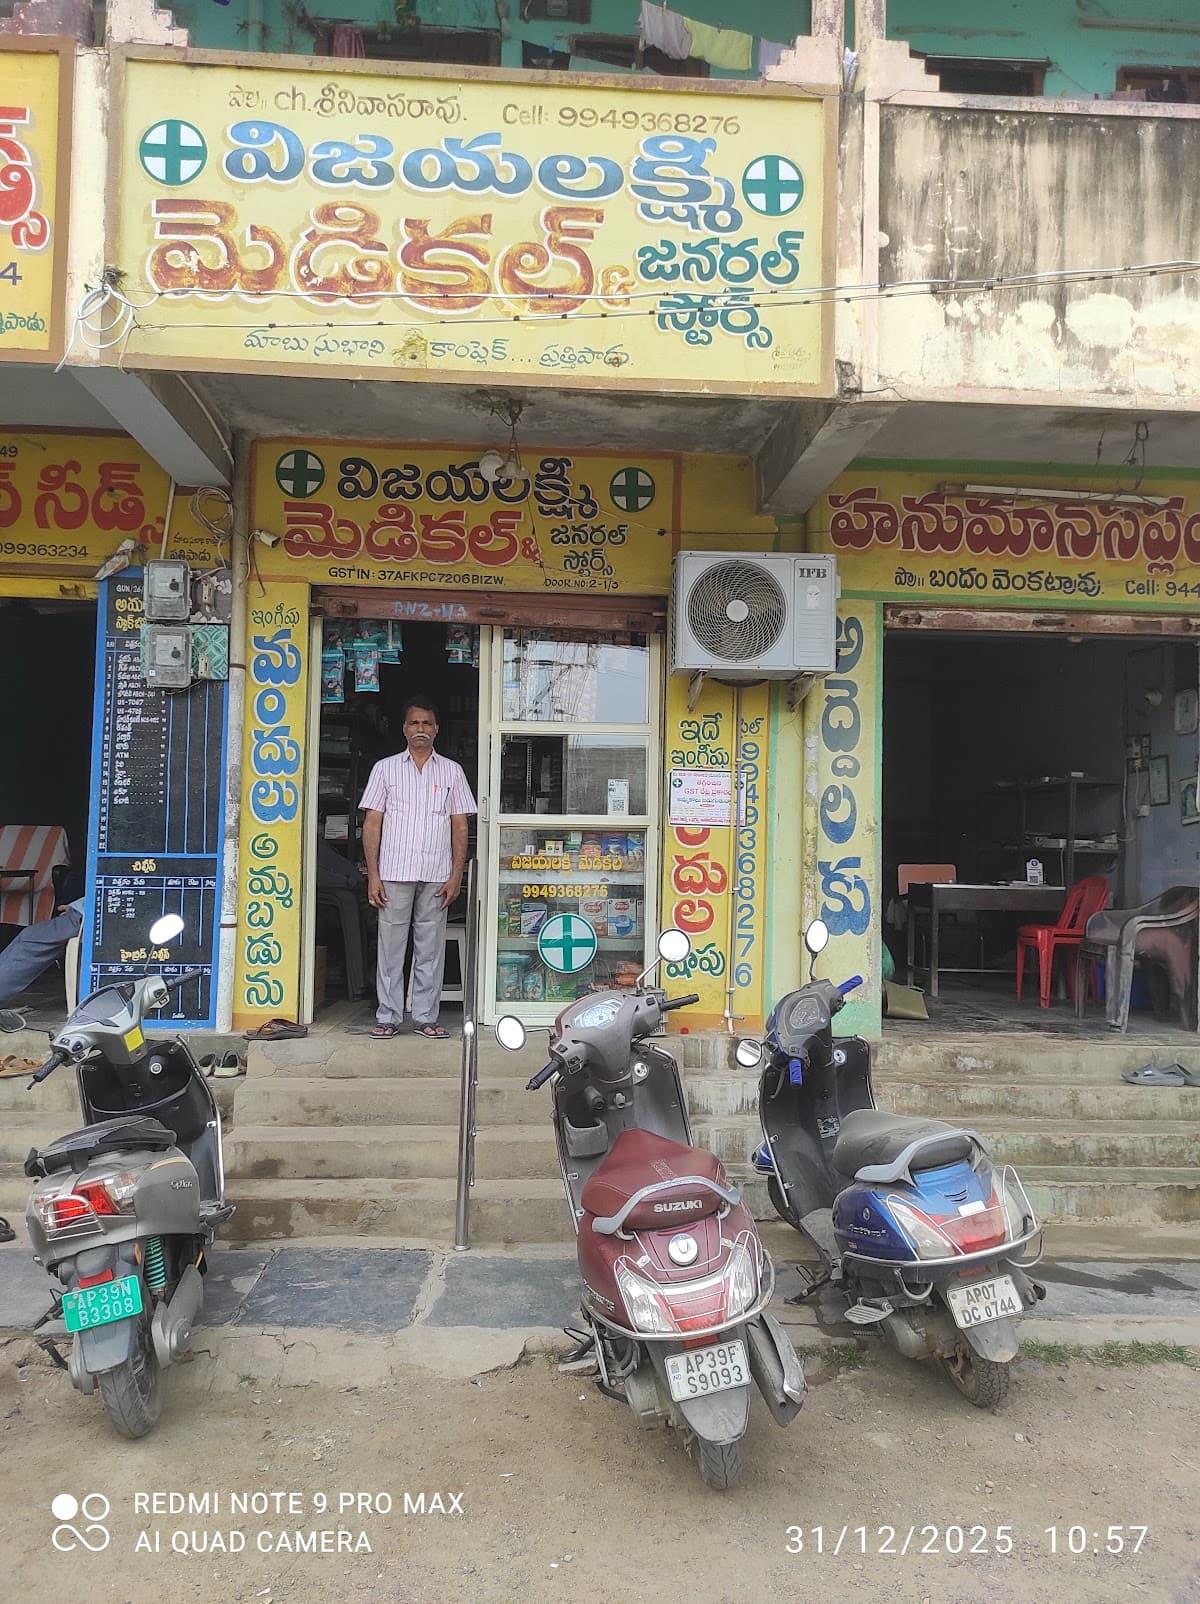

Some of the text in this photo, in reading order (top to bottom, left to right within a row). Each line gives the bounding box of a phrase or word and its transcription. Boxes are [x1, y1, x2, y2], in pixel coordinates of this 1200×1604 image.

[502, 103, 742, 136] Cell: 9949368276
[147, 198, 606, 316] మెడికల్
[636, 230, 805, 285] జనరల్
[282, 500, 524, 568] మెడికల్
[550, 523, 628, 546] జనరల్
[799, 567, 827, 579] IFB
[1124, 579, 1159, 596] Cell:
[1165, 581, 1200, 598] 944
[684, 787, 699, 795] GST
[522, 884, 609, 898] 9949368276
[653, 1199, 703, 1213] SUZUKI
[965, 1282, 997, 1302] AP07
[960, 1297, 1016, 1325] DC 0744
[686, 1345, 736, 1374] AP39F
[688, 1365, 743, 1394] S9093
